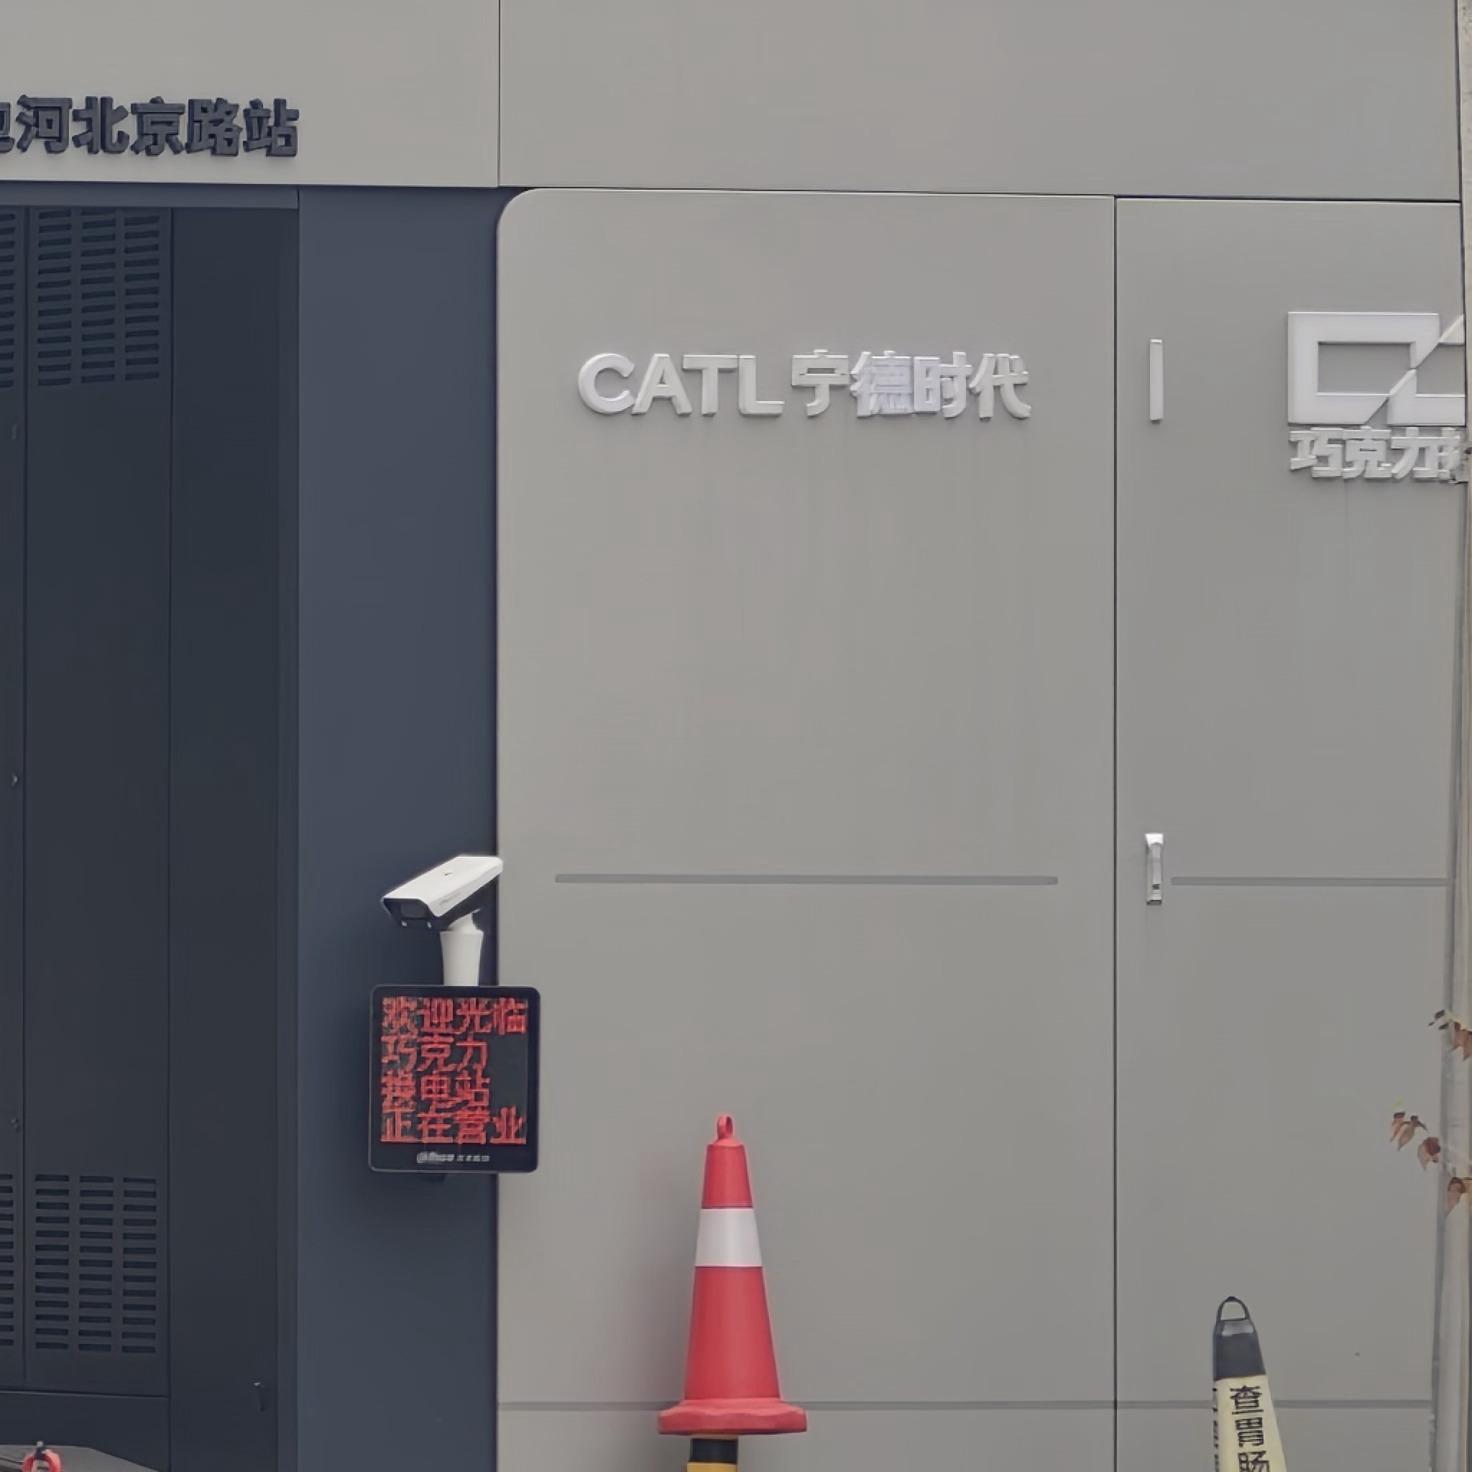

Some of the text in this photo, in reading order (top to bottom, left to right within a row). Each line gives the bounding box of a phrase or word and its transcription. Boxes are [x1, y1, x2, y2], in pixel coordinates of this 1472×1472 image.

[577, 348, 1033, 420] CATL 宁德时代
[381, 995, 529, 1036] 欢迎光临
[380, 1032, 489, 1073] 巧克力
[380, 1104, 528, 1145] 正在营业
